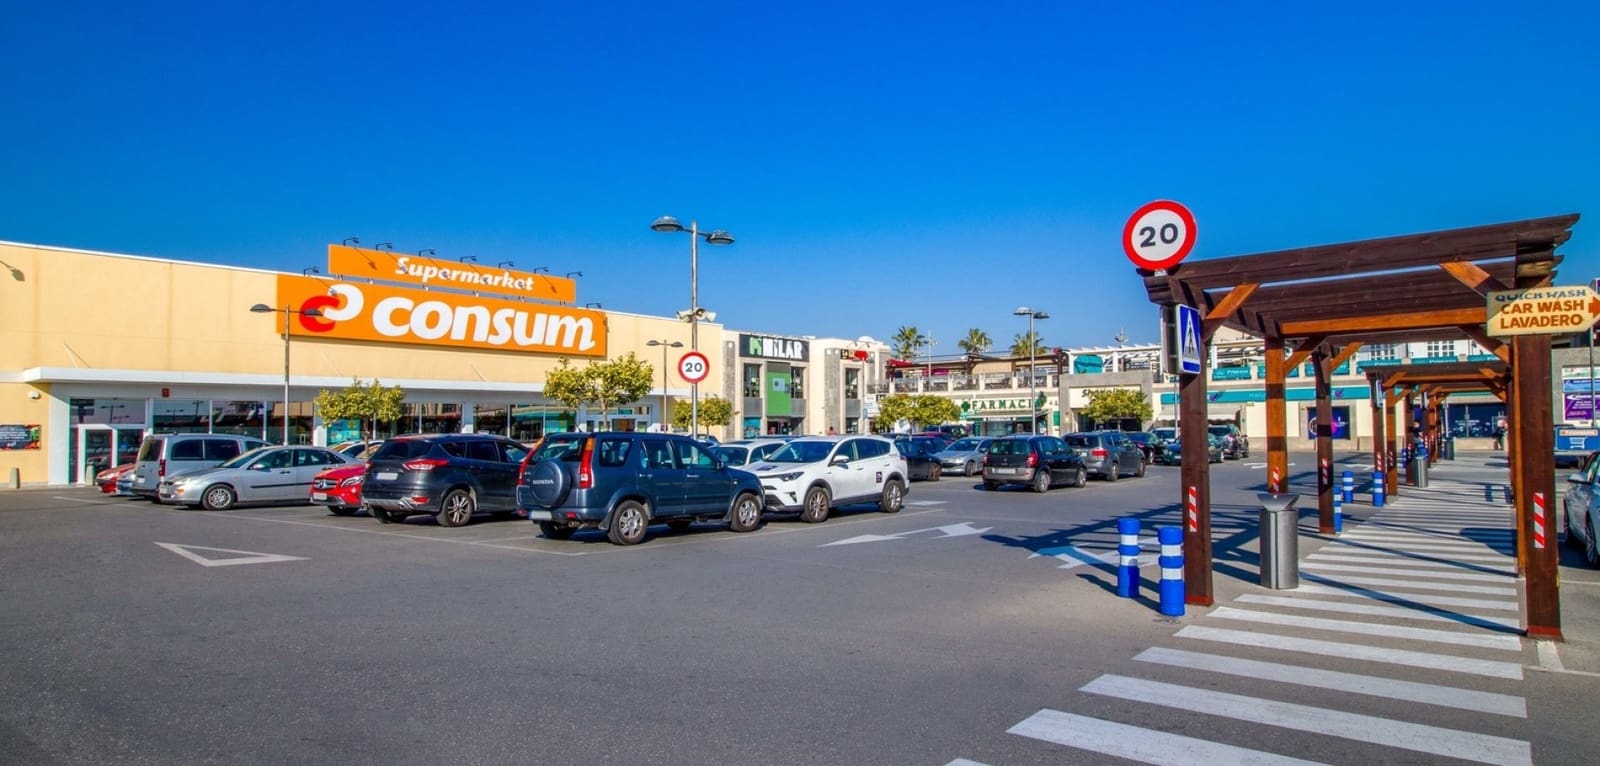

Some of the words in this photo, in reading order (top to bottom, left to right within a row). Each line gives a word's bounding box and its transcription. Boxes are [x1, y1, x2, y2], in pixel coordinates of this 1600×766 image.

[1139, 222, 1179, 248] 20
[395, 257, 535, 291] Supermarket
[1495, 292, 1543, 302] QUICK
[1547, 289, 1586, 299] WASH
[1501, 303, 1533, 315] CAR
[1537, 300, 1585, 313] WASH
[372, 296, 596, 351] consum
[1500, 313, 1584, 330] LAVADERO
[684, 362, 703, 373] 20
[972, 399, 1040, 410] FARMACI
